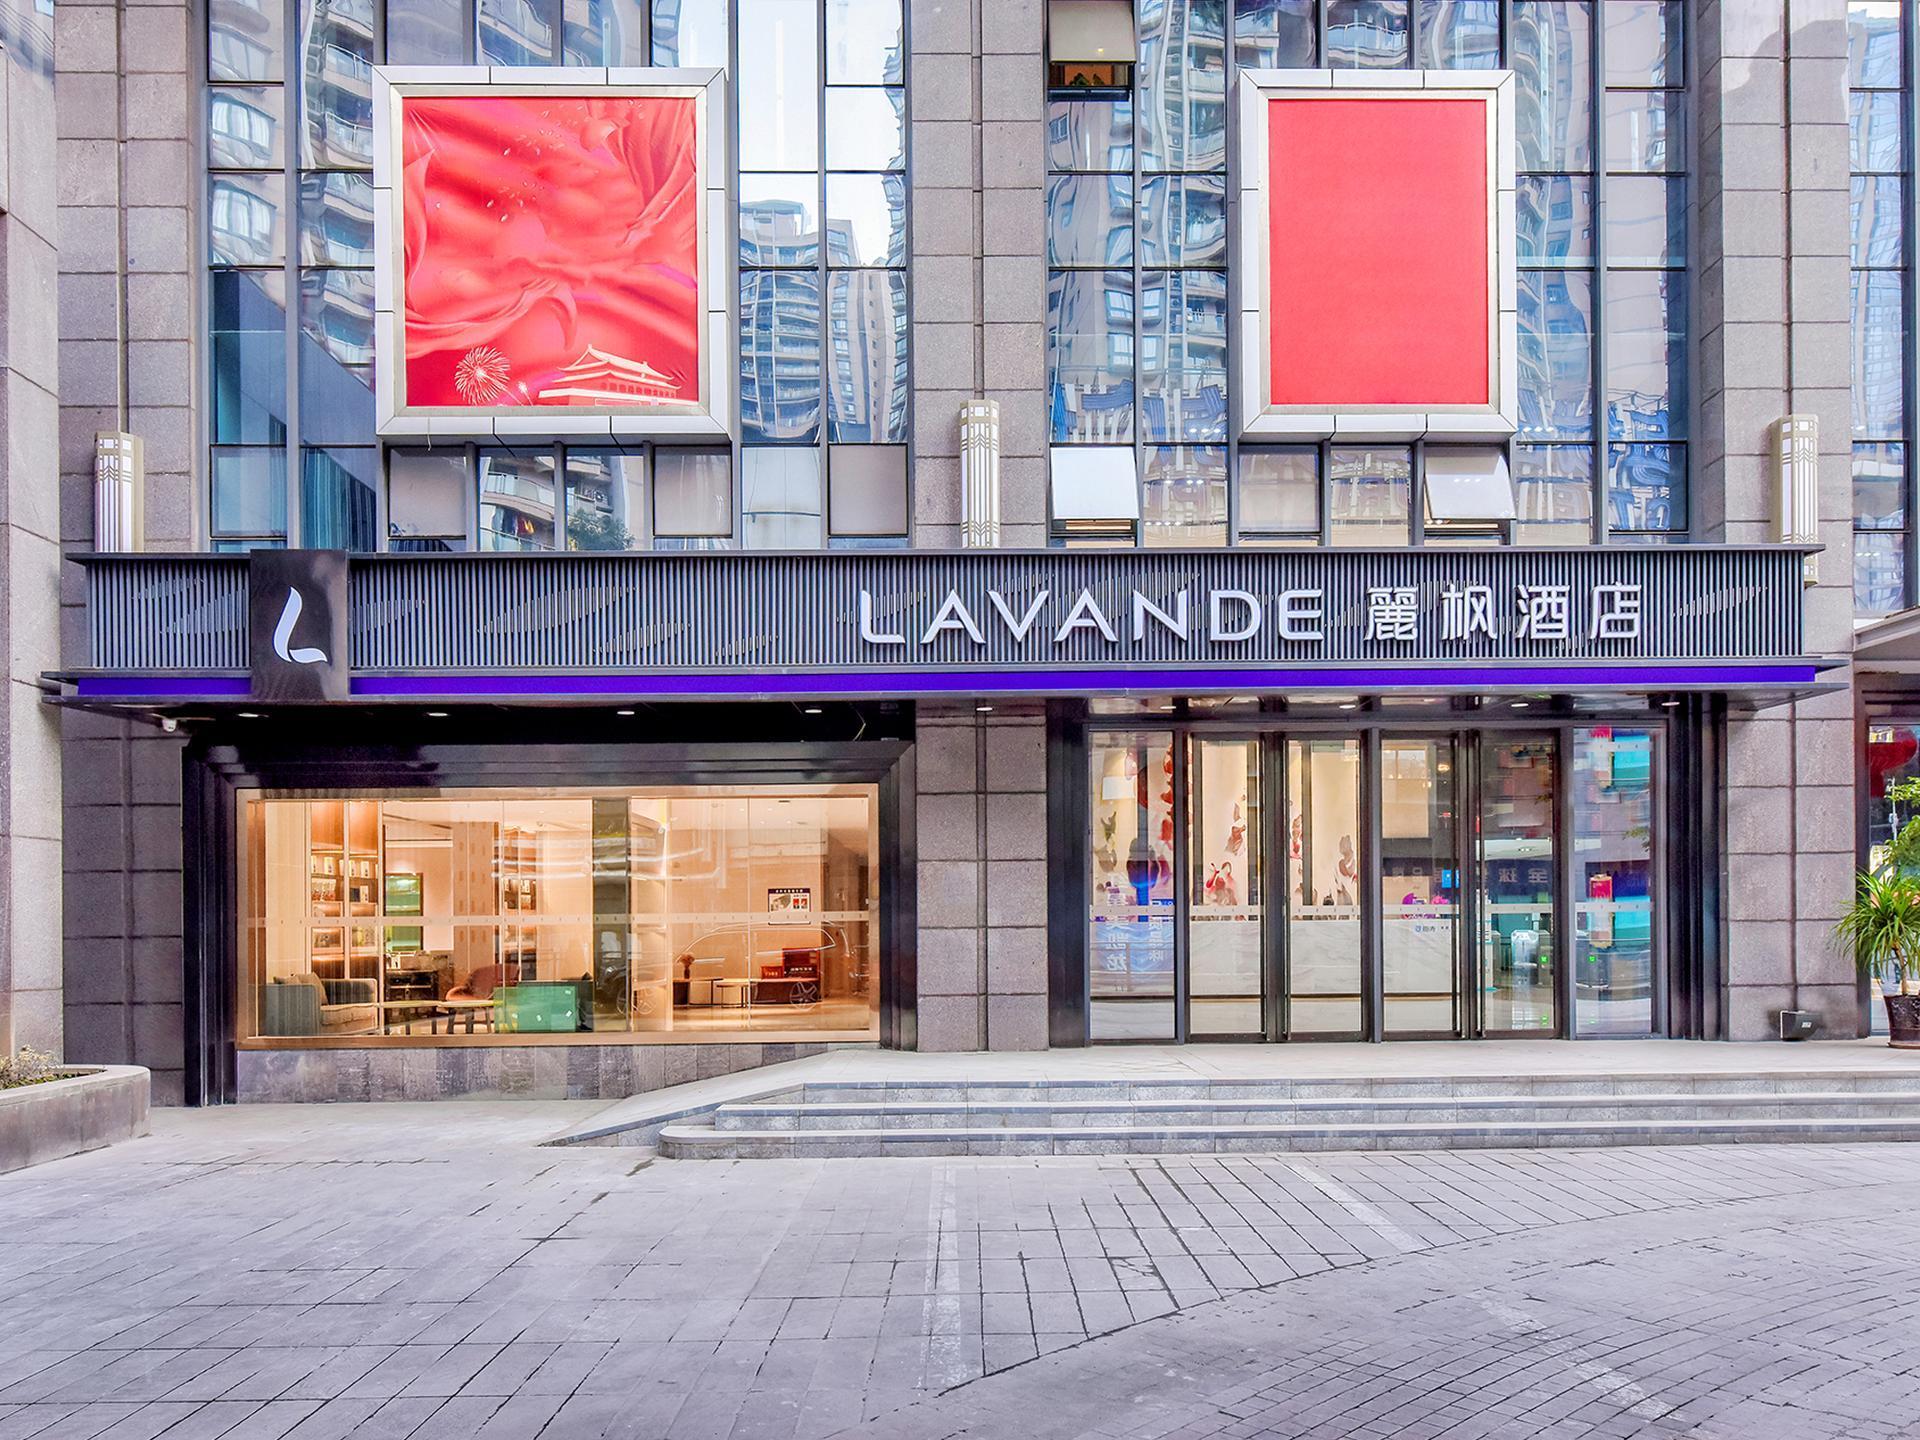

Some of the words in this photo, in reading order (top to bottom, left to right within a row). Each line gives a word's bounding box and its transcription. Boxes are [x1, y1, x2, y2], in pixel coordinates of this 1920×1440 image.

[861, 588, 1324, 644] LAVANDE
[1364, 582, 1642, 641] 麗枫酒店
